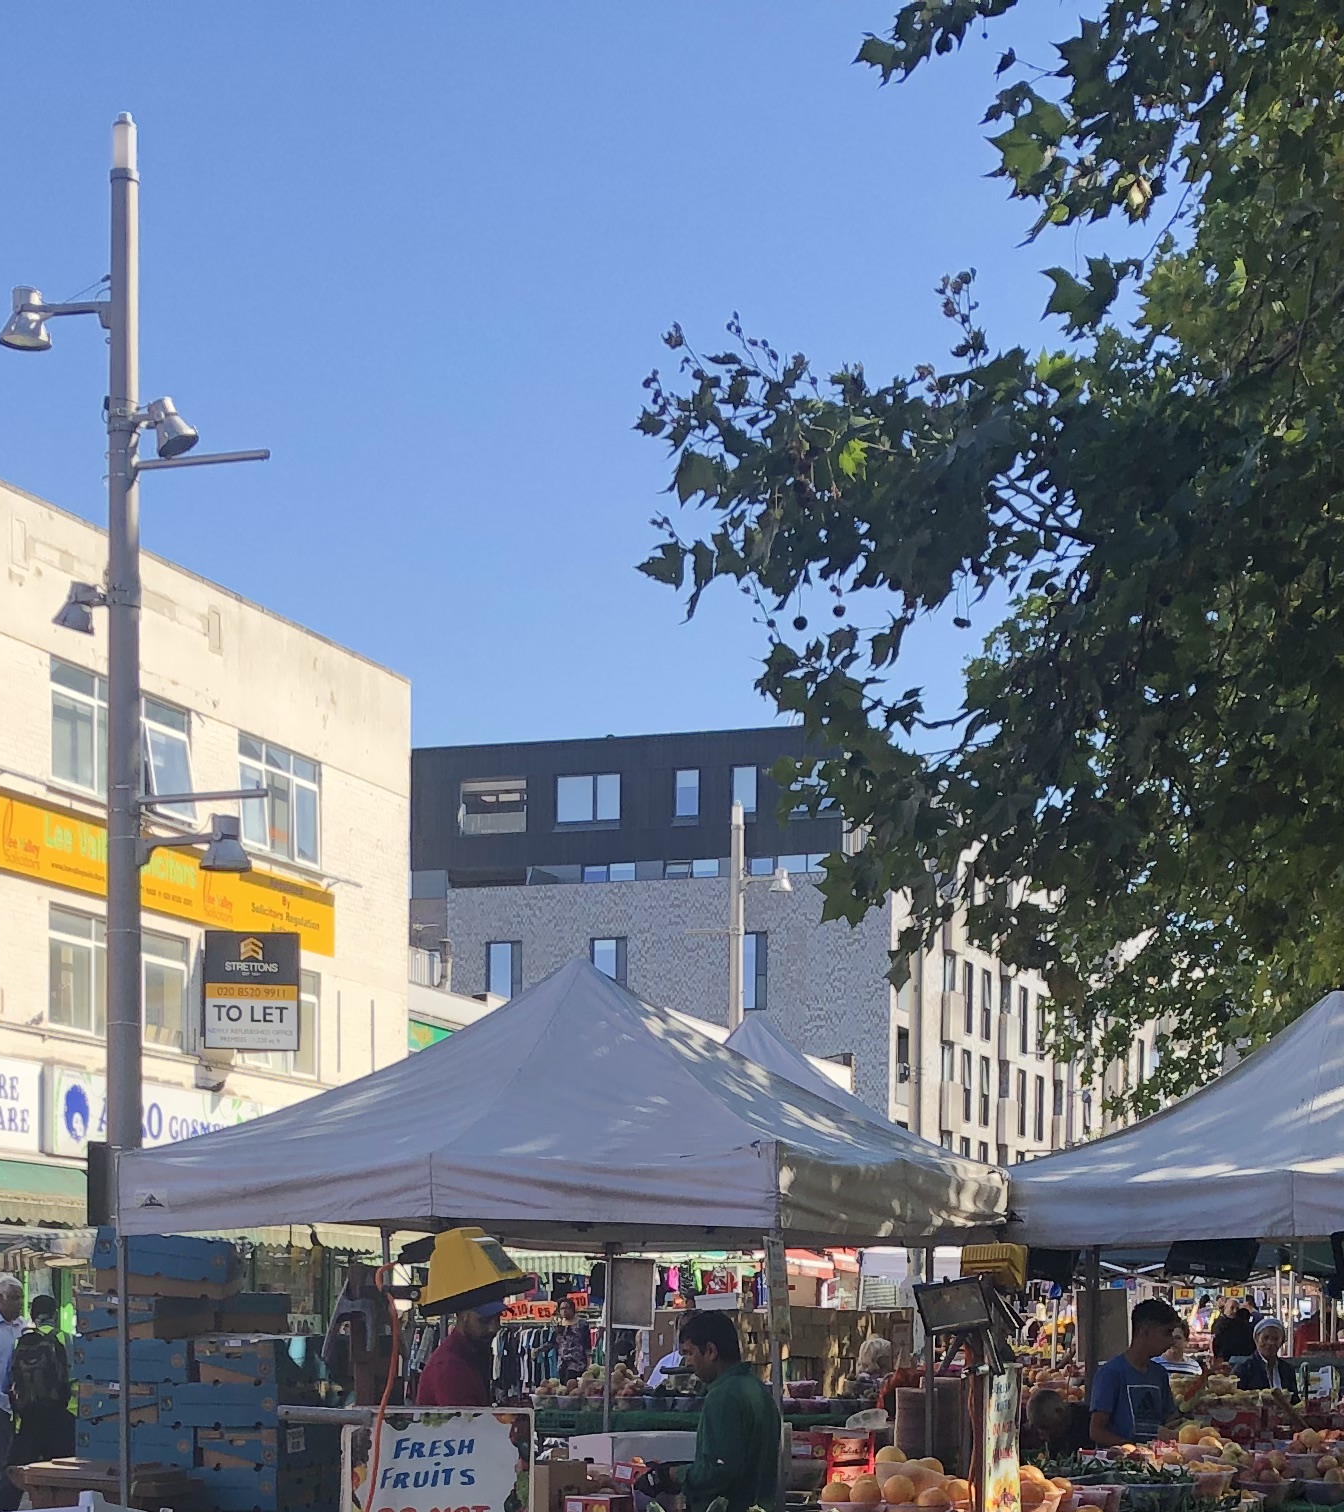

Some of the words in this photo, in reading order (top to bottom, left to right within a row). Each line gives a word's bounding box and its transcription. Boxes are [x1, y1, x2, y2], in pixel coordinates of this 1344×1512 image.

[44, 814, 73, 853] Lee
[282, 896, 291, 910] By
[251, 902, 284, 921] Solicitors
[285, 911, 320, 931] Regulation
[225, 961, 279, 973] STRETTONS
[217, 987, 234, 996] 020
[238, 987, 261, 997] 8520
[265, 989, 286, 998] 9911
[213, 1005, 242, 1022] TO
[250, 1006, 288, 1023] LET
[537, 1306, 551, 1318] £5
[392, 1437, 476, 1460] FRESH
